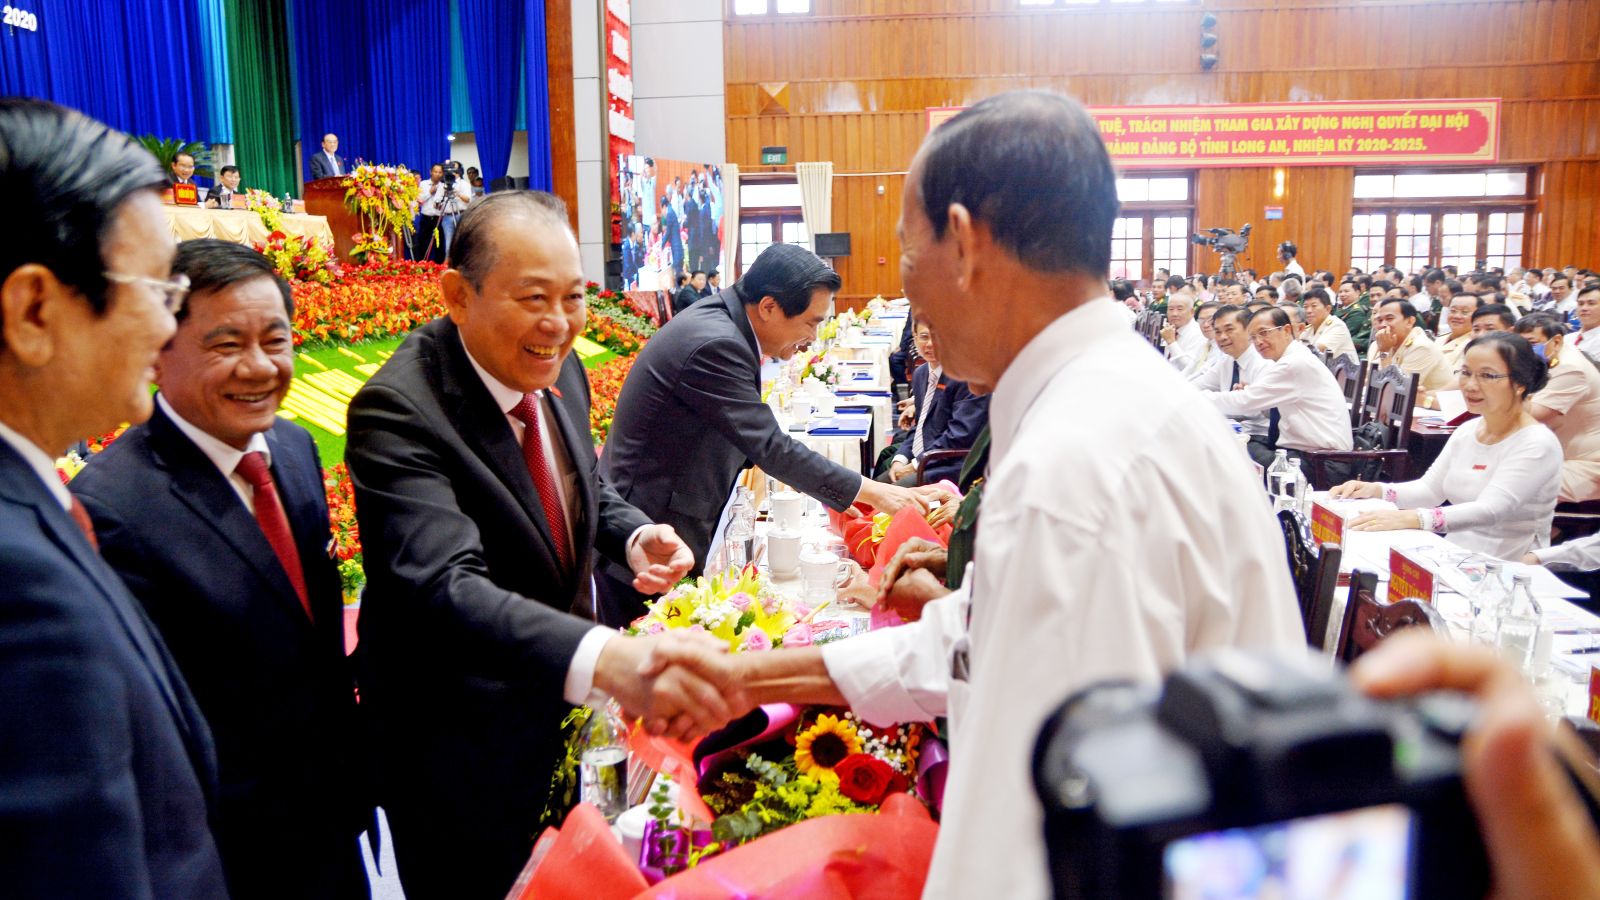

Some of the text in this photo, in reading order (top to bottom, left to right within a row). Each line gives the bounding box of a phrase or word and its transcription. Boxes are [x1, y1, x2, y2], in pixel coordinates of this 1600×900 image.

[3, 5, 38, 32] 2020
[1099, 110, 1469, 136] TUỆ, TRÁCH NHIỆM THAM GIA XÂY DỰNG NGHỊ QUYẾT ĐẠI HỘI
[767, 154, 781, 163] EXIT
[1141, 136, 1177, 154] ĐẢNG
[1180, 138, 1197, 158] BỘ
[1200, 135, 1229, 154] TỈNH
[1231, 139, 1266, 153] LONG
[1268, 139, 1290, 155] AN,
[1293, 136, 1335, 155] NHIỆM
[1357, 137, 1426, 152] 2020-2025.
